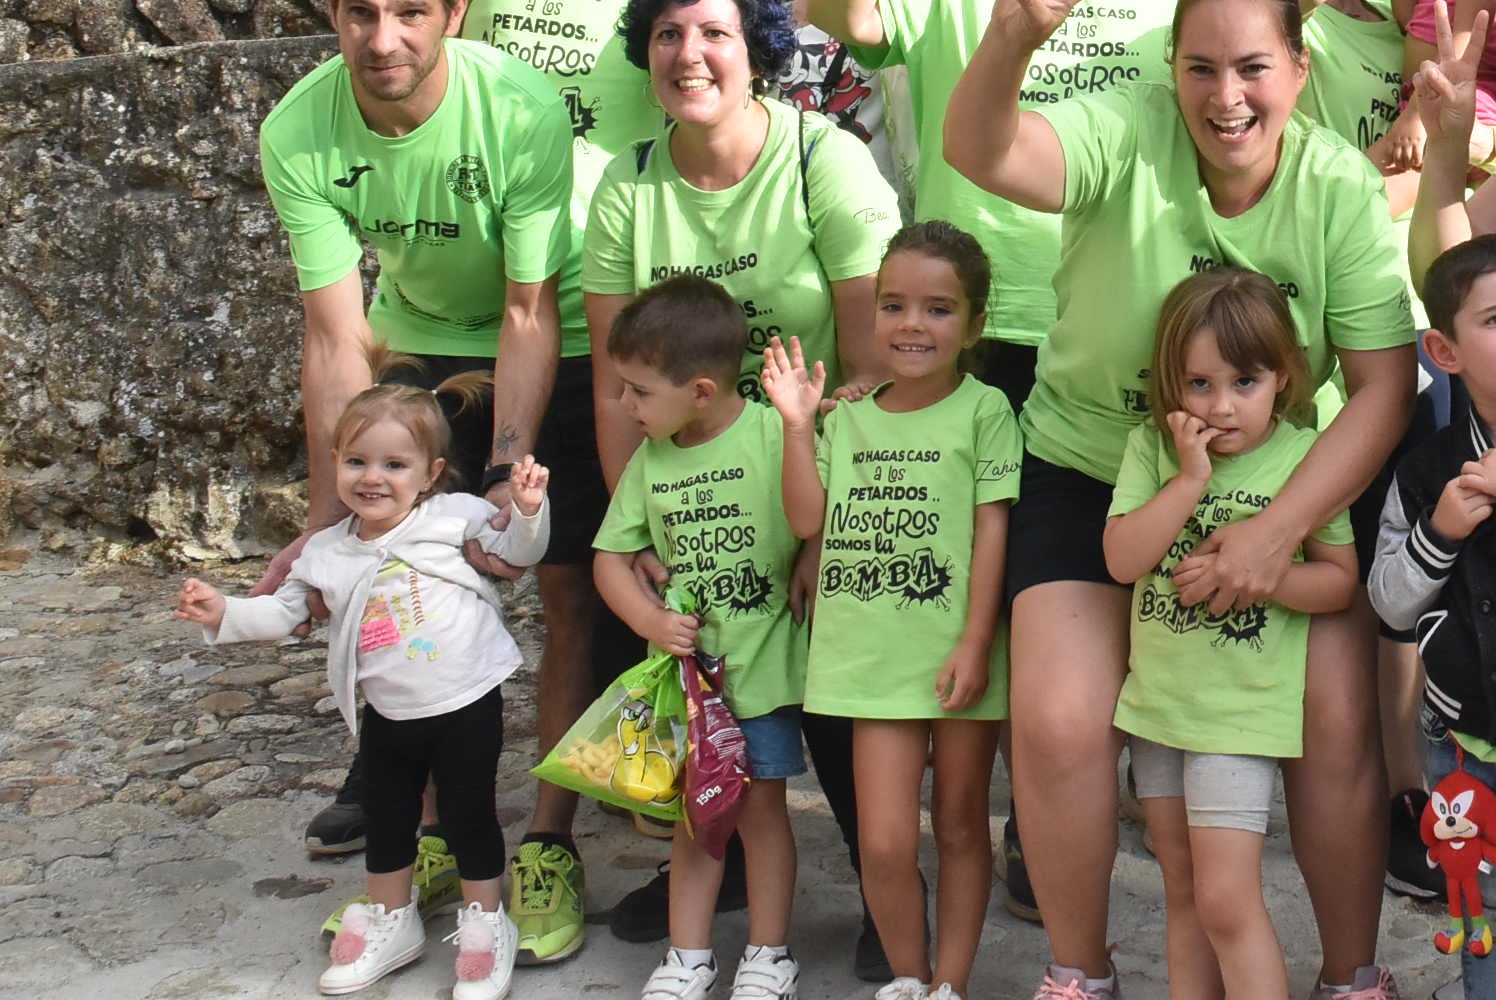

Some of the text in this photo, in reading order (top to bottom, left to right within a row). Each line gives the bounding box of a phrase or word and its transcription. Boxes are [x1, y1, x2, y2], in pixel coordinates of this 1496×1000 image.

[1097, 7, 1137, 20] CASO
[650, 266, 668, 281] NO
[724, 252, 757, 275] CASO
[852, 450, 941, 465] NO HAGAS CASO
[651, 467, 744, 494] NO HAGAS CASO
[1236, 491, 1271, 509] CASO
[825, 538, 872, 551] SOMOS
[697, 785, 723, 806] 150g
